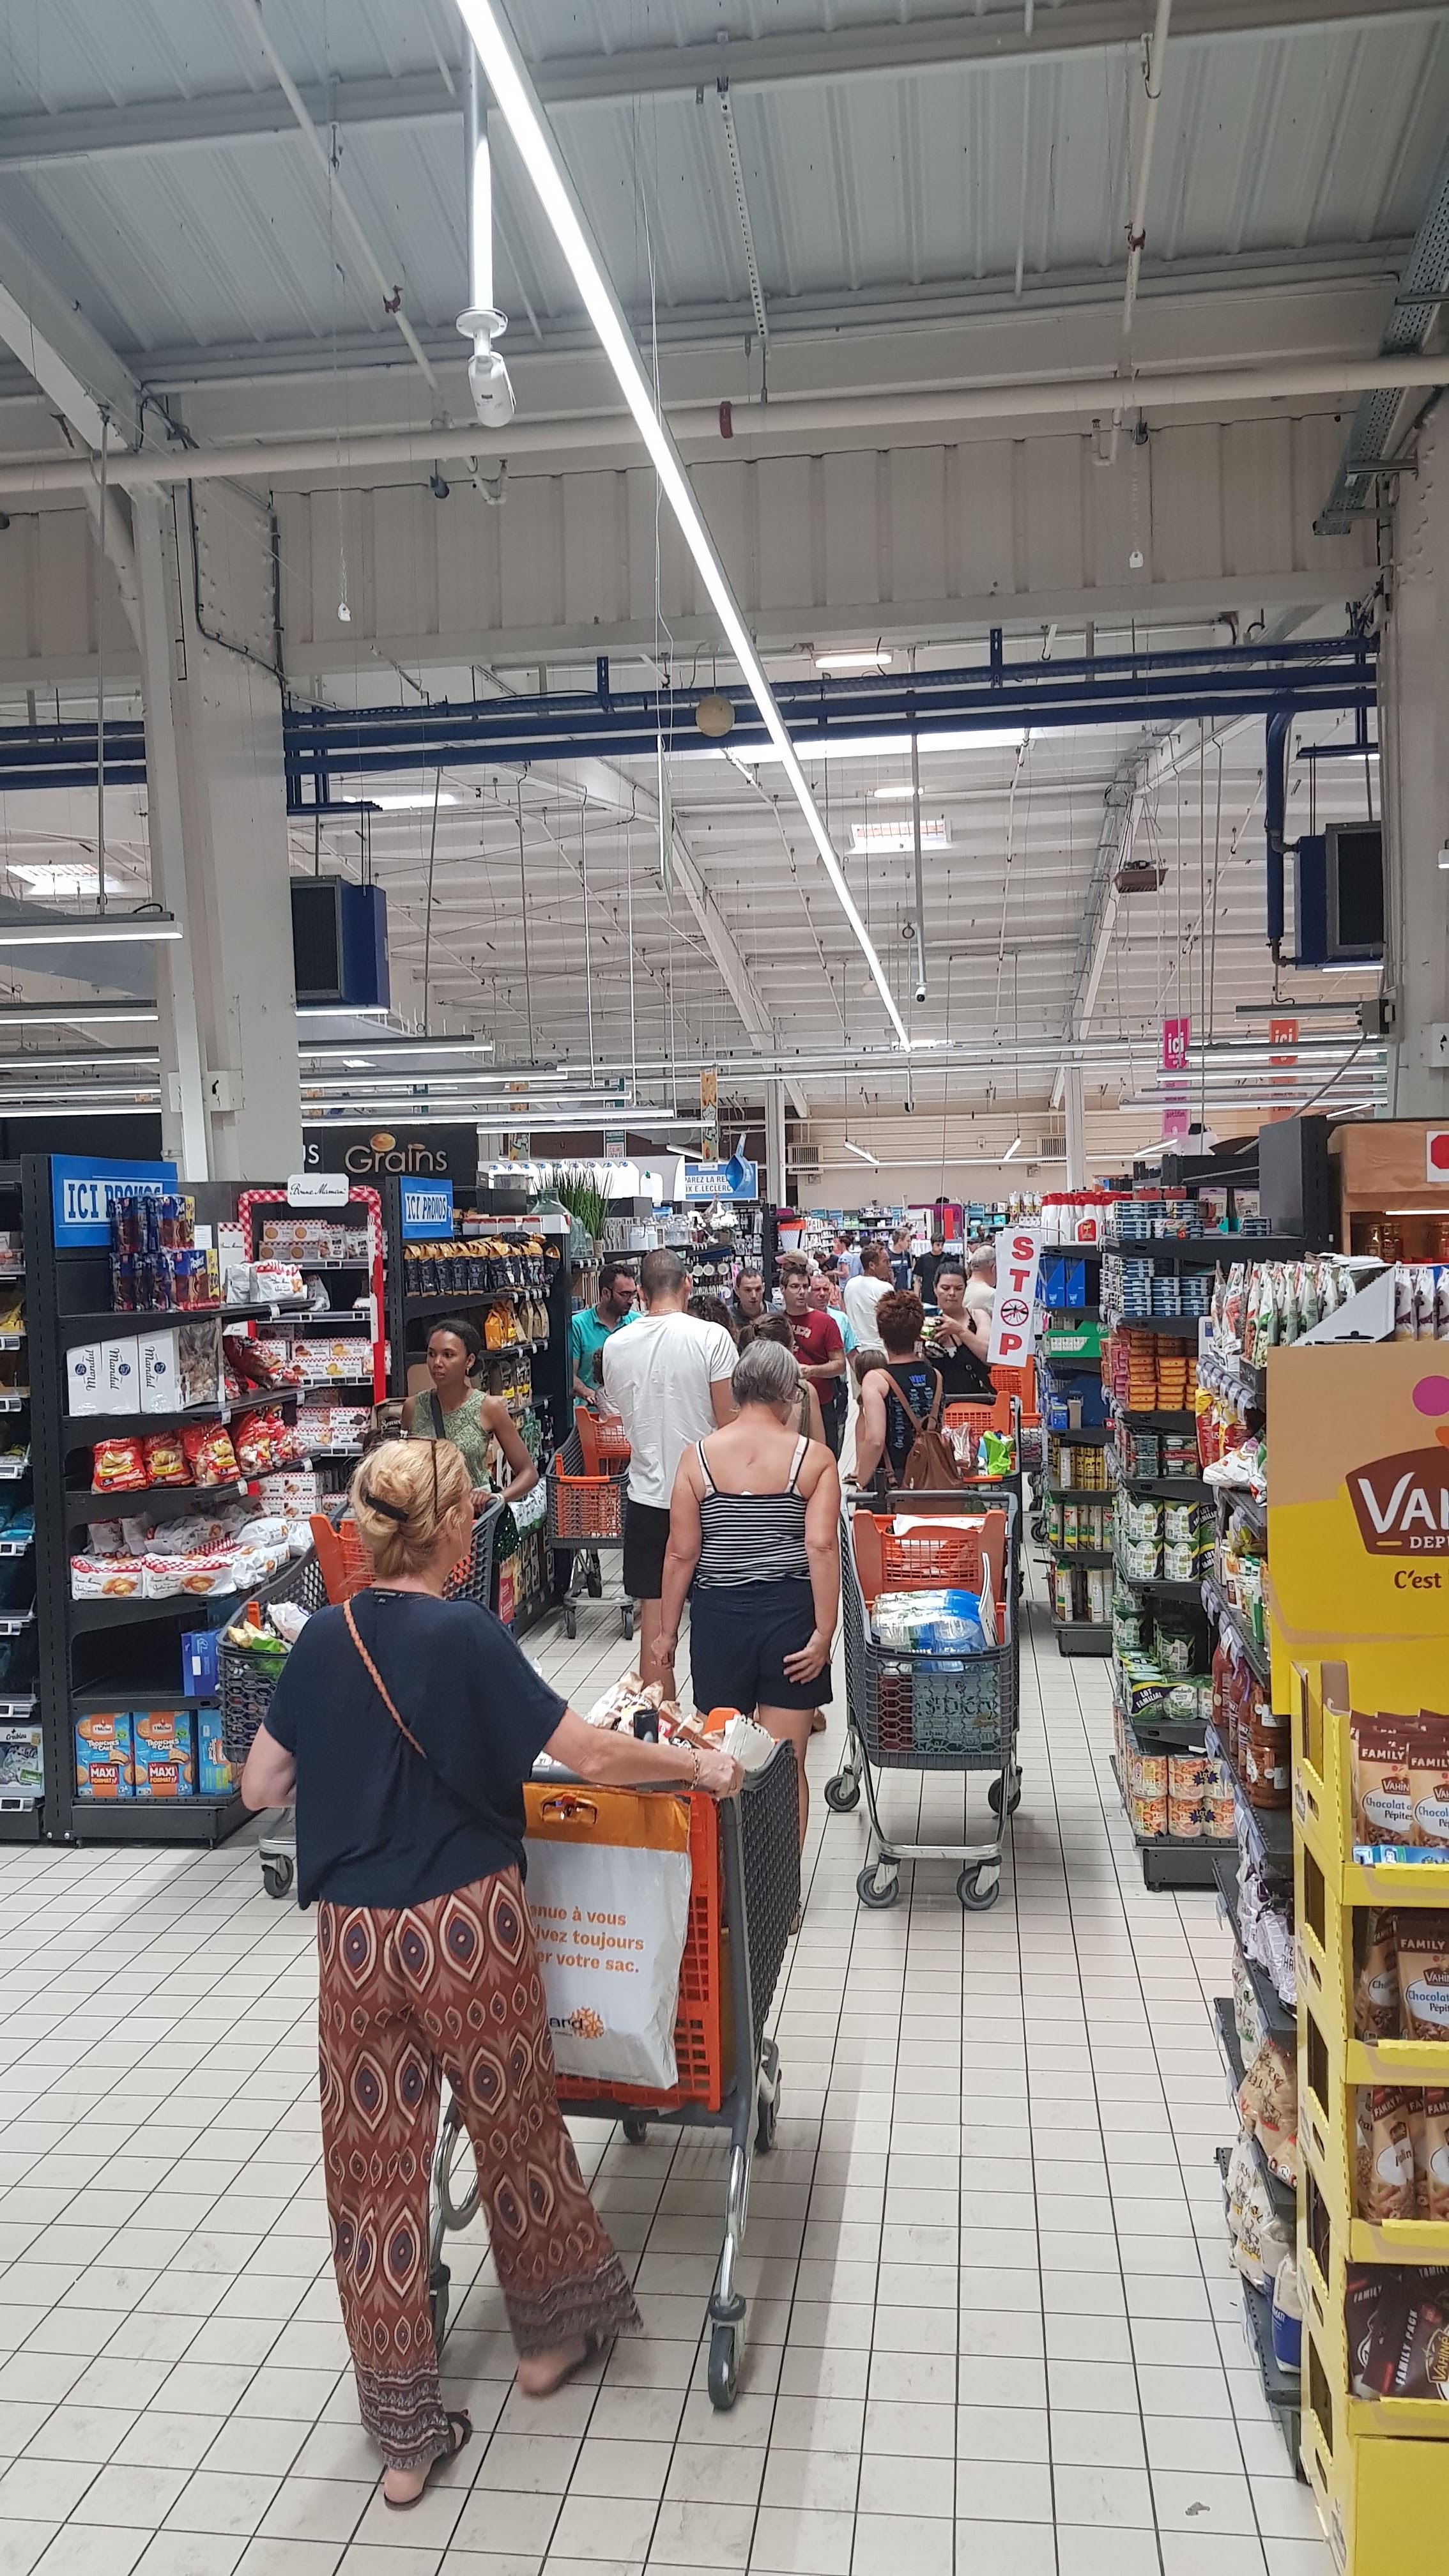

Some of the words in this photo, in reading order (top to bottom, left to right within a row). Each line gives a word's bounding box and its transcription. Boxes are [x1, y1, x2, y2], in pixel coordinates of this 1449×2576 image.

[345, 1143, 447, 1174] Grains
[68, 1184, 98, 1218] ICI
[407, 1196, 420, 1220] ICI
[423, 1197, 447, 1220] PROMOS
[85, 1349, 96, 1391] Mandul
[109, 1347, 120, 1390] Mandul
[144, 1346, 156, 1388] Mandul
[1395, 1570, 1442, 1589] C'est
[1136, 1692, 1163, 1708] FAMILIAL
[1140, 1689, 1153, 1698] LOT
[1361, 1748, 1404, 1760] FAMILY
[91, 1768, 115, 1777] MAXI
[150, 1768, 174, 1777] MAXI
[1366, 1797, 1402, 1810] Chocolat
[572, 1906, 582, 1922] à
[587, 1912, 626, 1926] vous
[572, 1930, 644, 1951] toujours
[1400, 1939, 1445, 1950] FAMILY
[556, 1953, 600, 1969] votre
[606, 1959, 639, 1973] sac.
[1395, 2343, 1411, 2386] FAMILY
[1406, 2310, 1418, 2340] PACK
